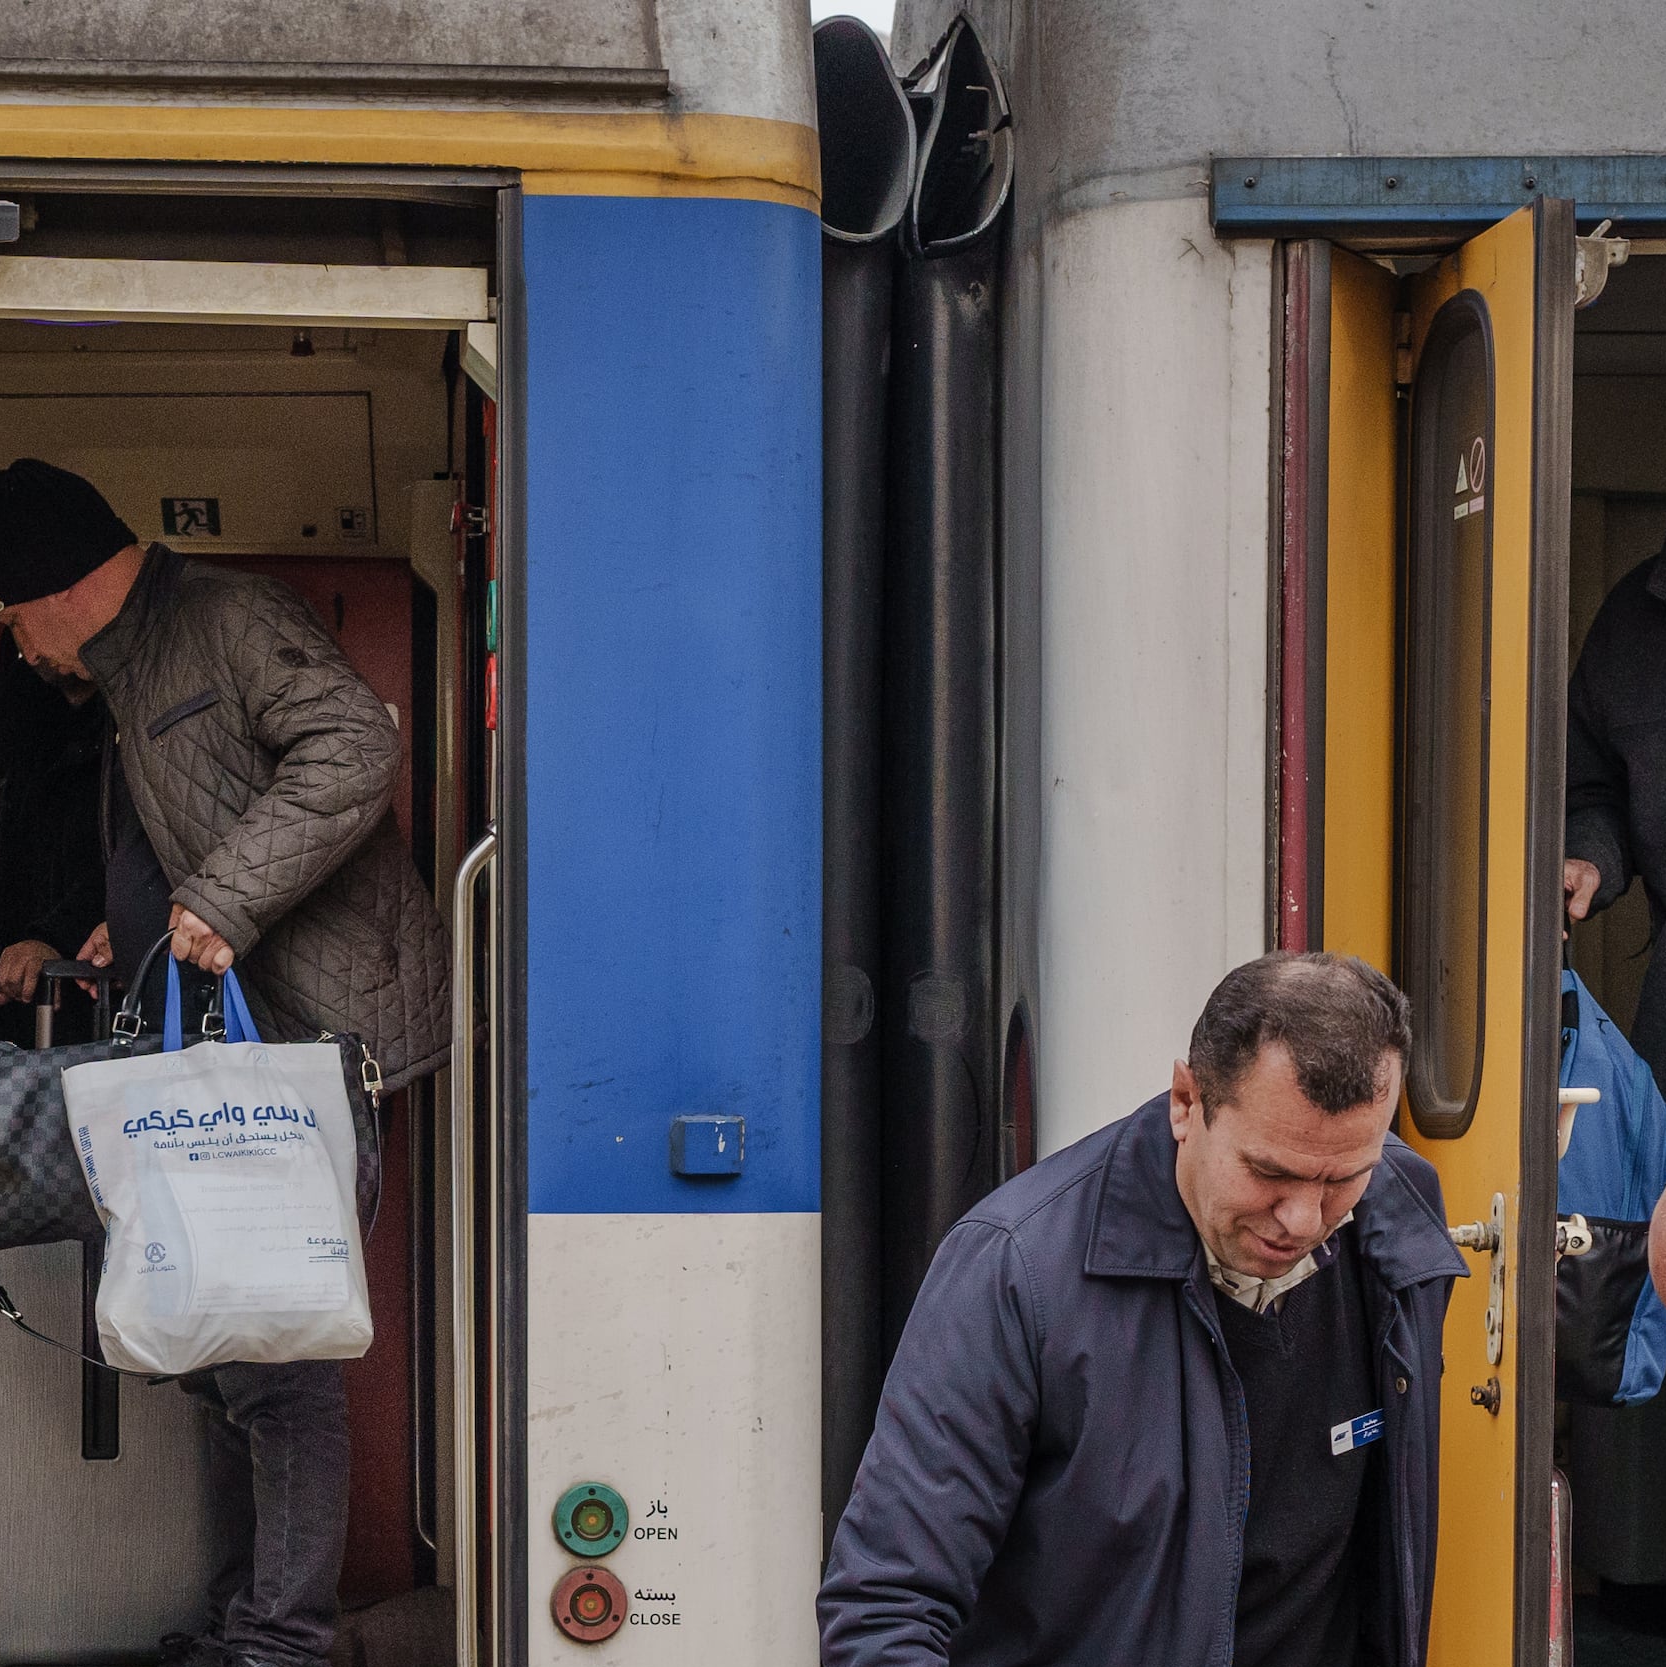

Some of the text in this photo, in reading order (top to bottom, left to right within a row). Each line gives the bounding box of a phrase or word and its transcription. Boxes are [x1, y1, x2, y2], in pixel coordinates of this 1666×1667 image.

[122, 1108, 194, 1139] كيكي
[198, 1101, 245, 1132] واي
[252, 1104, 299, 1127] سي
[646, 1499, 668, 1519] باز
[634, 1527, 678, 1540] OPEN
[634, 1588, 676, 1606] بسته
[629, 1613, 681, 1625] CLOSE
